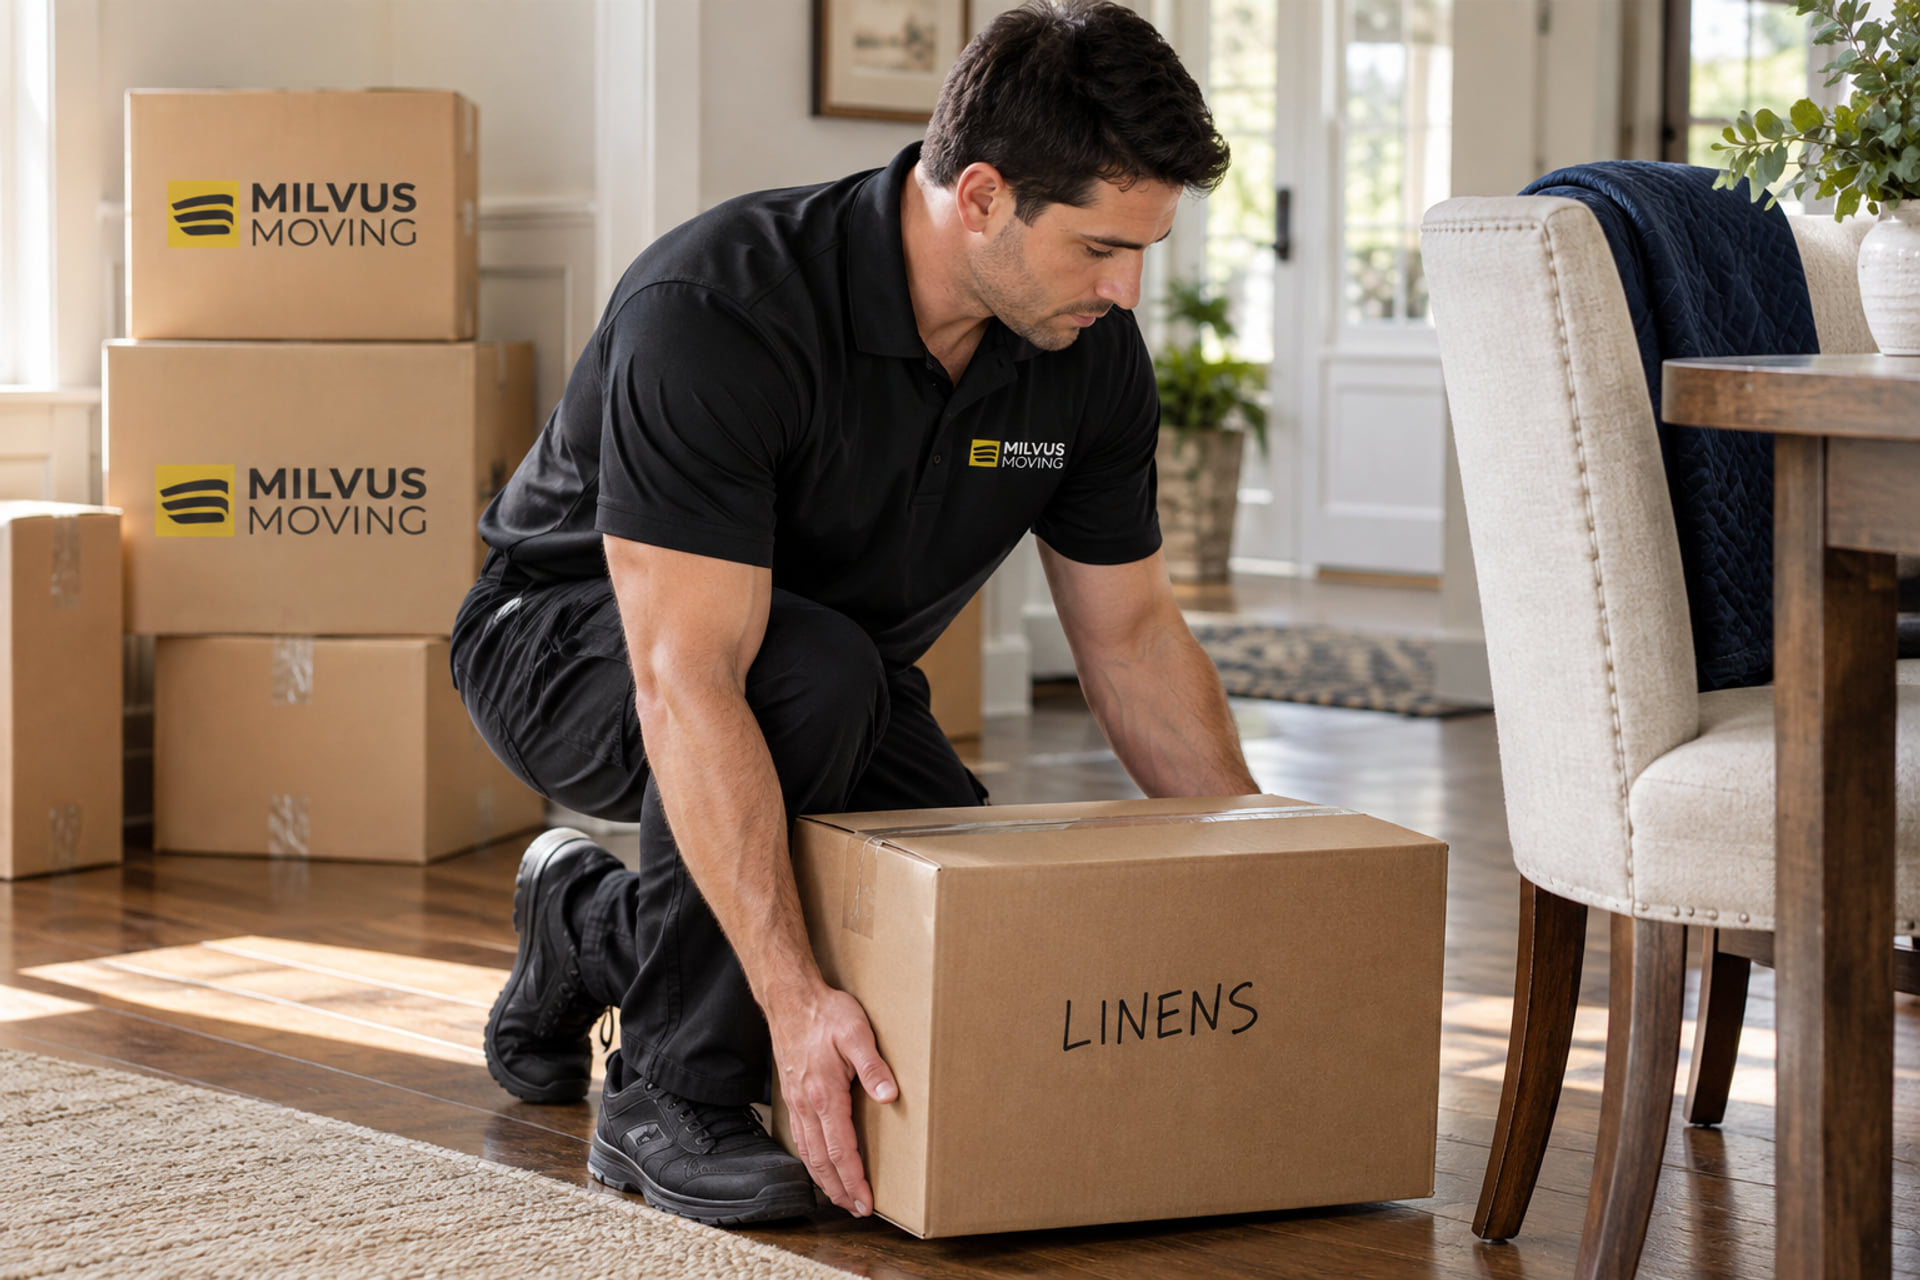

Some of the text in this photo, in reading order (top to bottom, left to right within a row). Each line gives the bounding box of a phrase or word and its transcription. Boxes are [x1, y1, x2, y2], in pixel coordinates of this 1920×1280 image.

[252, 183, 416, 213] MILVUS
[253, 219, 416, 246] MOVING
[1001, 456, 1064, 469] MOVING
[1003, 441, 1065, 456] MILVUS
[249, 467, 426, 499] MILVUS
[249, 506, 426, 535] MOVING
[1063, 982, 1258, 1051] LINENS
